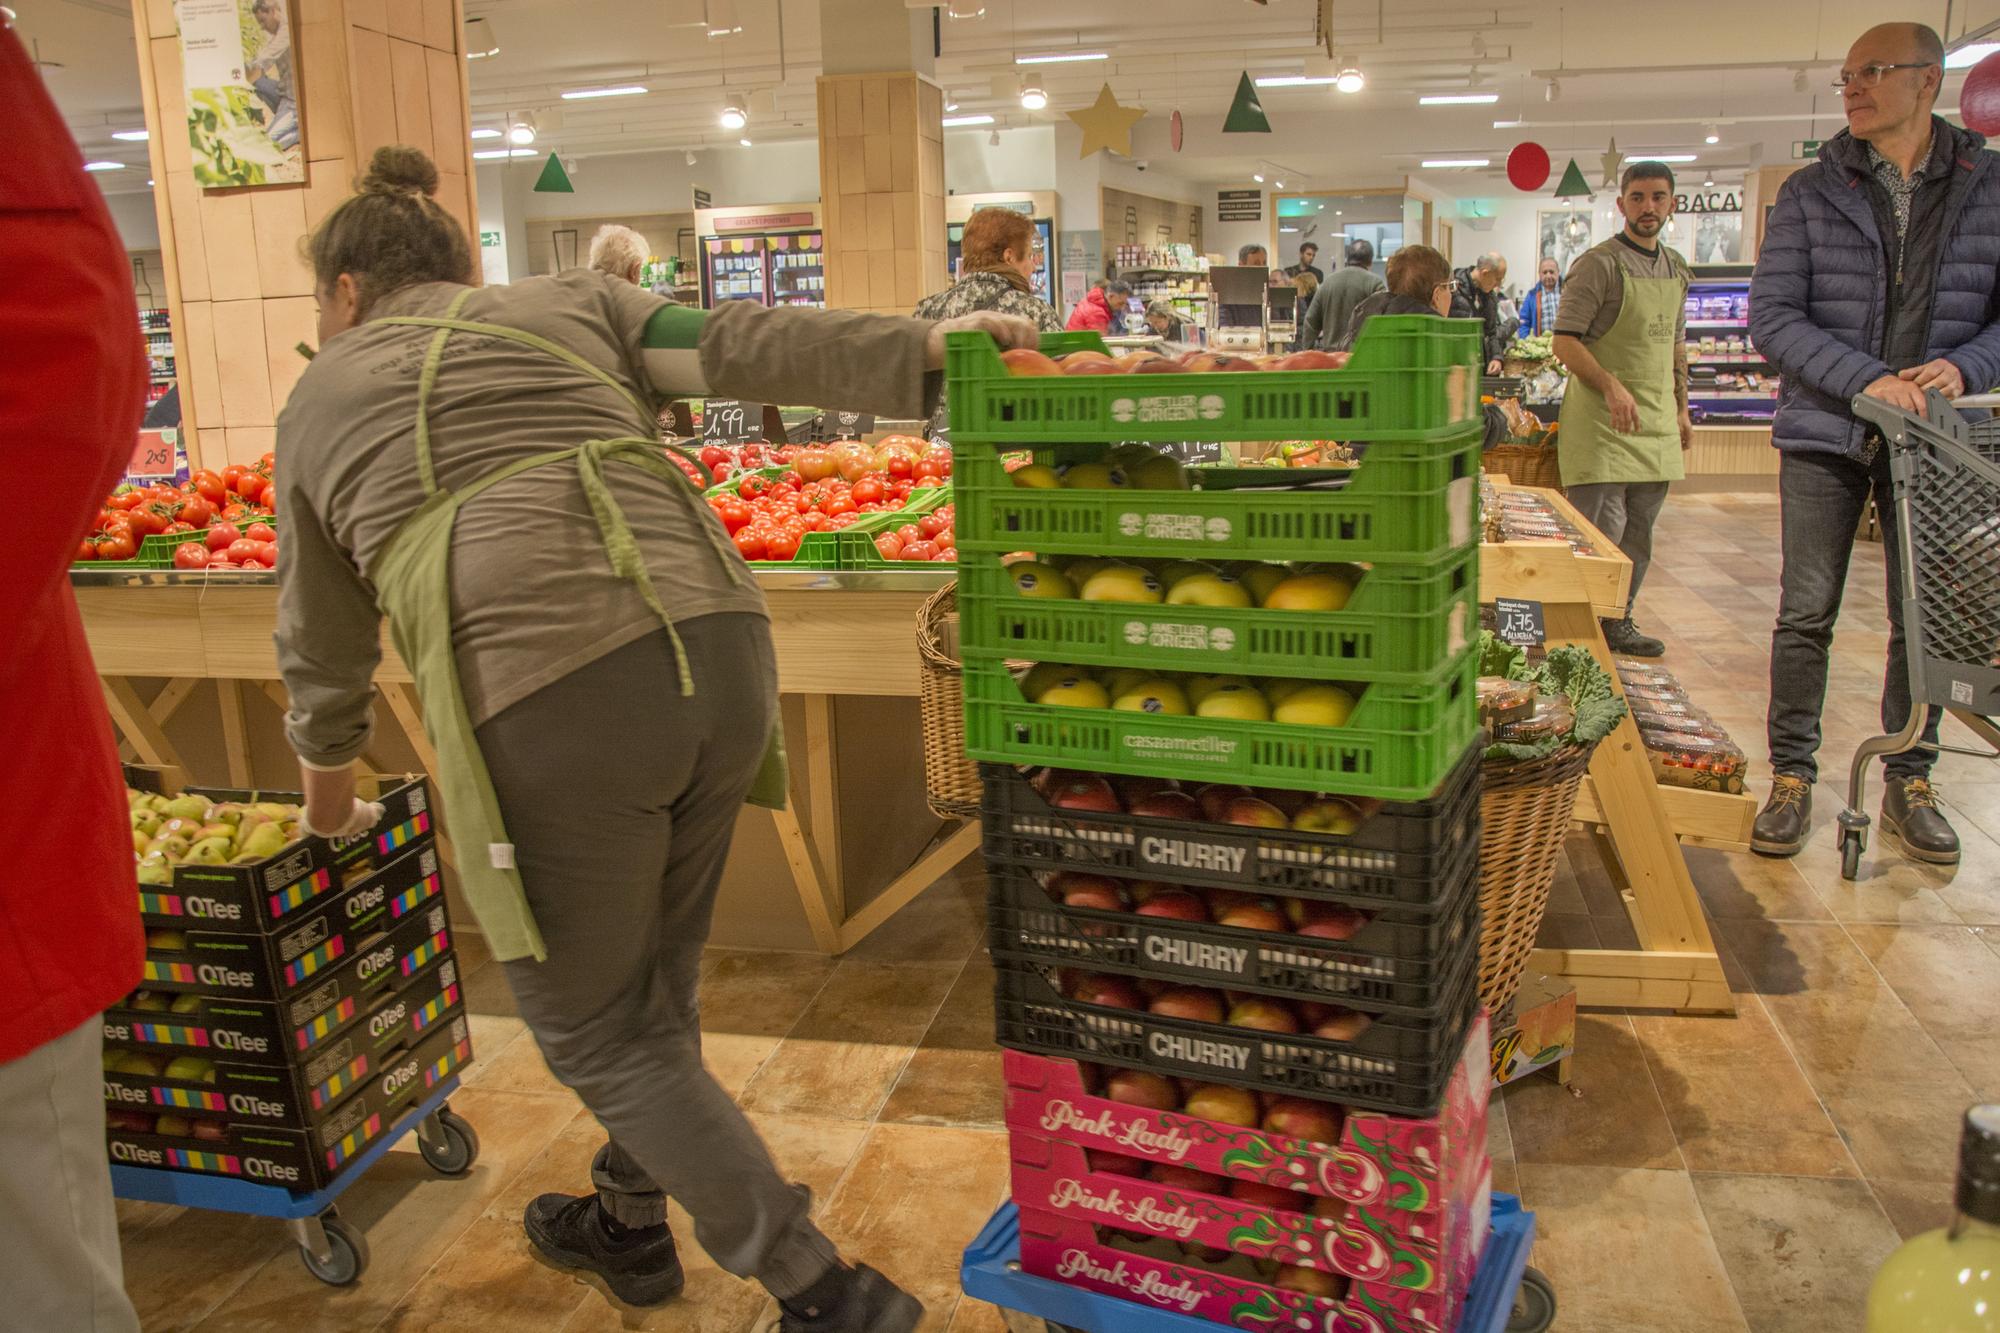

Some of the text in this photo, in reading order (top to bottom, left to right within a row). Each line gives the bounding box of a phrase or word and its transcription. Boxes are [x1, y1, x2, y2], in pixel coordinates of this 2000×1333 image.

[1675, 192, 1744, 213] BACA
[704, 408, 744, 436] 1,99
[1138, 407, 1199, 422] ORIGEN
[1145, 525, 1205, 541] ORIGEN
[1505, 613, 1534, 631] 1,75
[1149, 634, 1209, 650] ORIGEN
[1141, 836, 1246, 873] CHURRY
[185, 896, 242, 920] QTee
[345, 885, 384, 919] QTee
[356, 945, 395, 979] QTee
[1144, 935, 1248, 973] CHURRY
[198, 964, 254, 988] QTee
[369, 1001, 406, 1036] QTee
[104, 1024, 130, 1040] ee
[212, 1029, 268, 1053] QTee
[1149, 1032, 1250, 1070] CHURRY
[382, 1059, 419, 1096] QTee
[229, 1094, 285, 1118] QTee
[1040, 1099, 1193, 1160] Pink Lady
[111, 1141, 162, 1164] QTee
[244, 1157, 299, 1181] QTee
[1048, 1178, 1200, 1238] Pink Lady
[1056, 1248, 1203, 1311] Pink Lady
